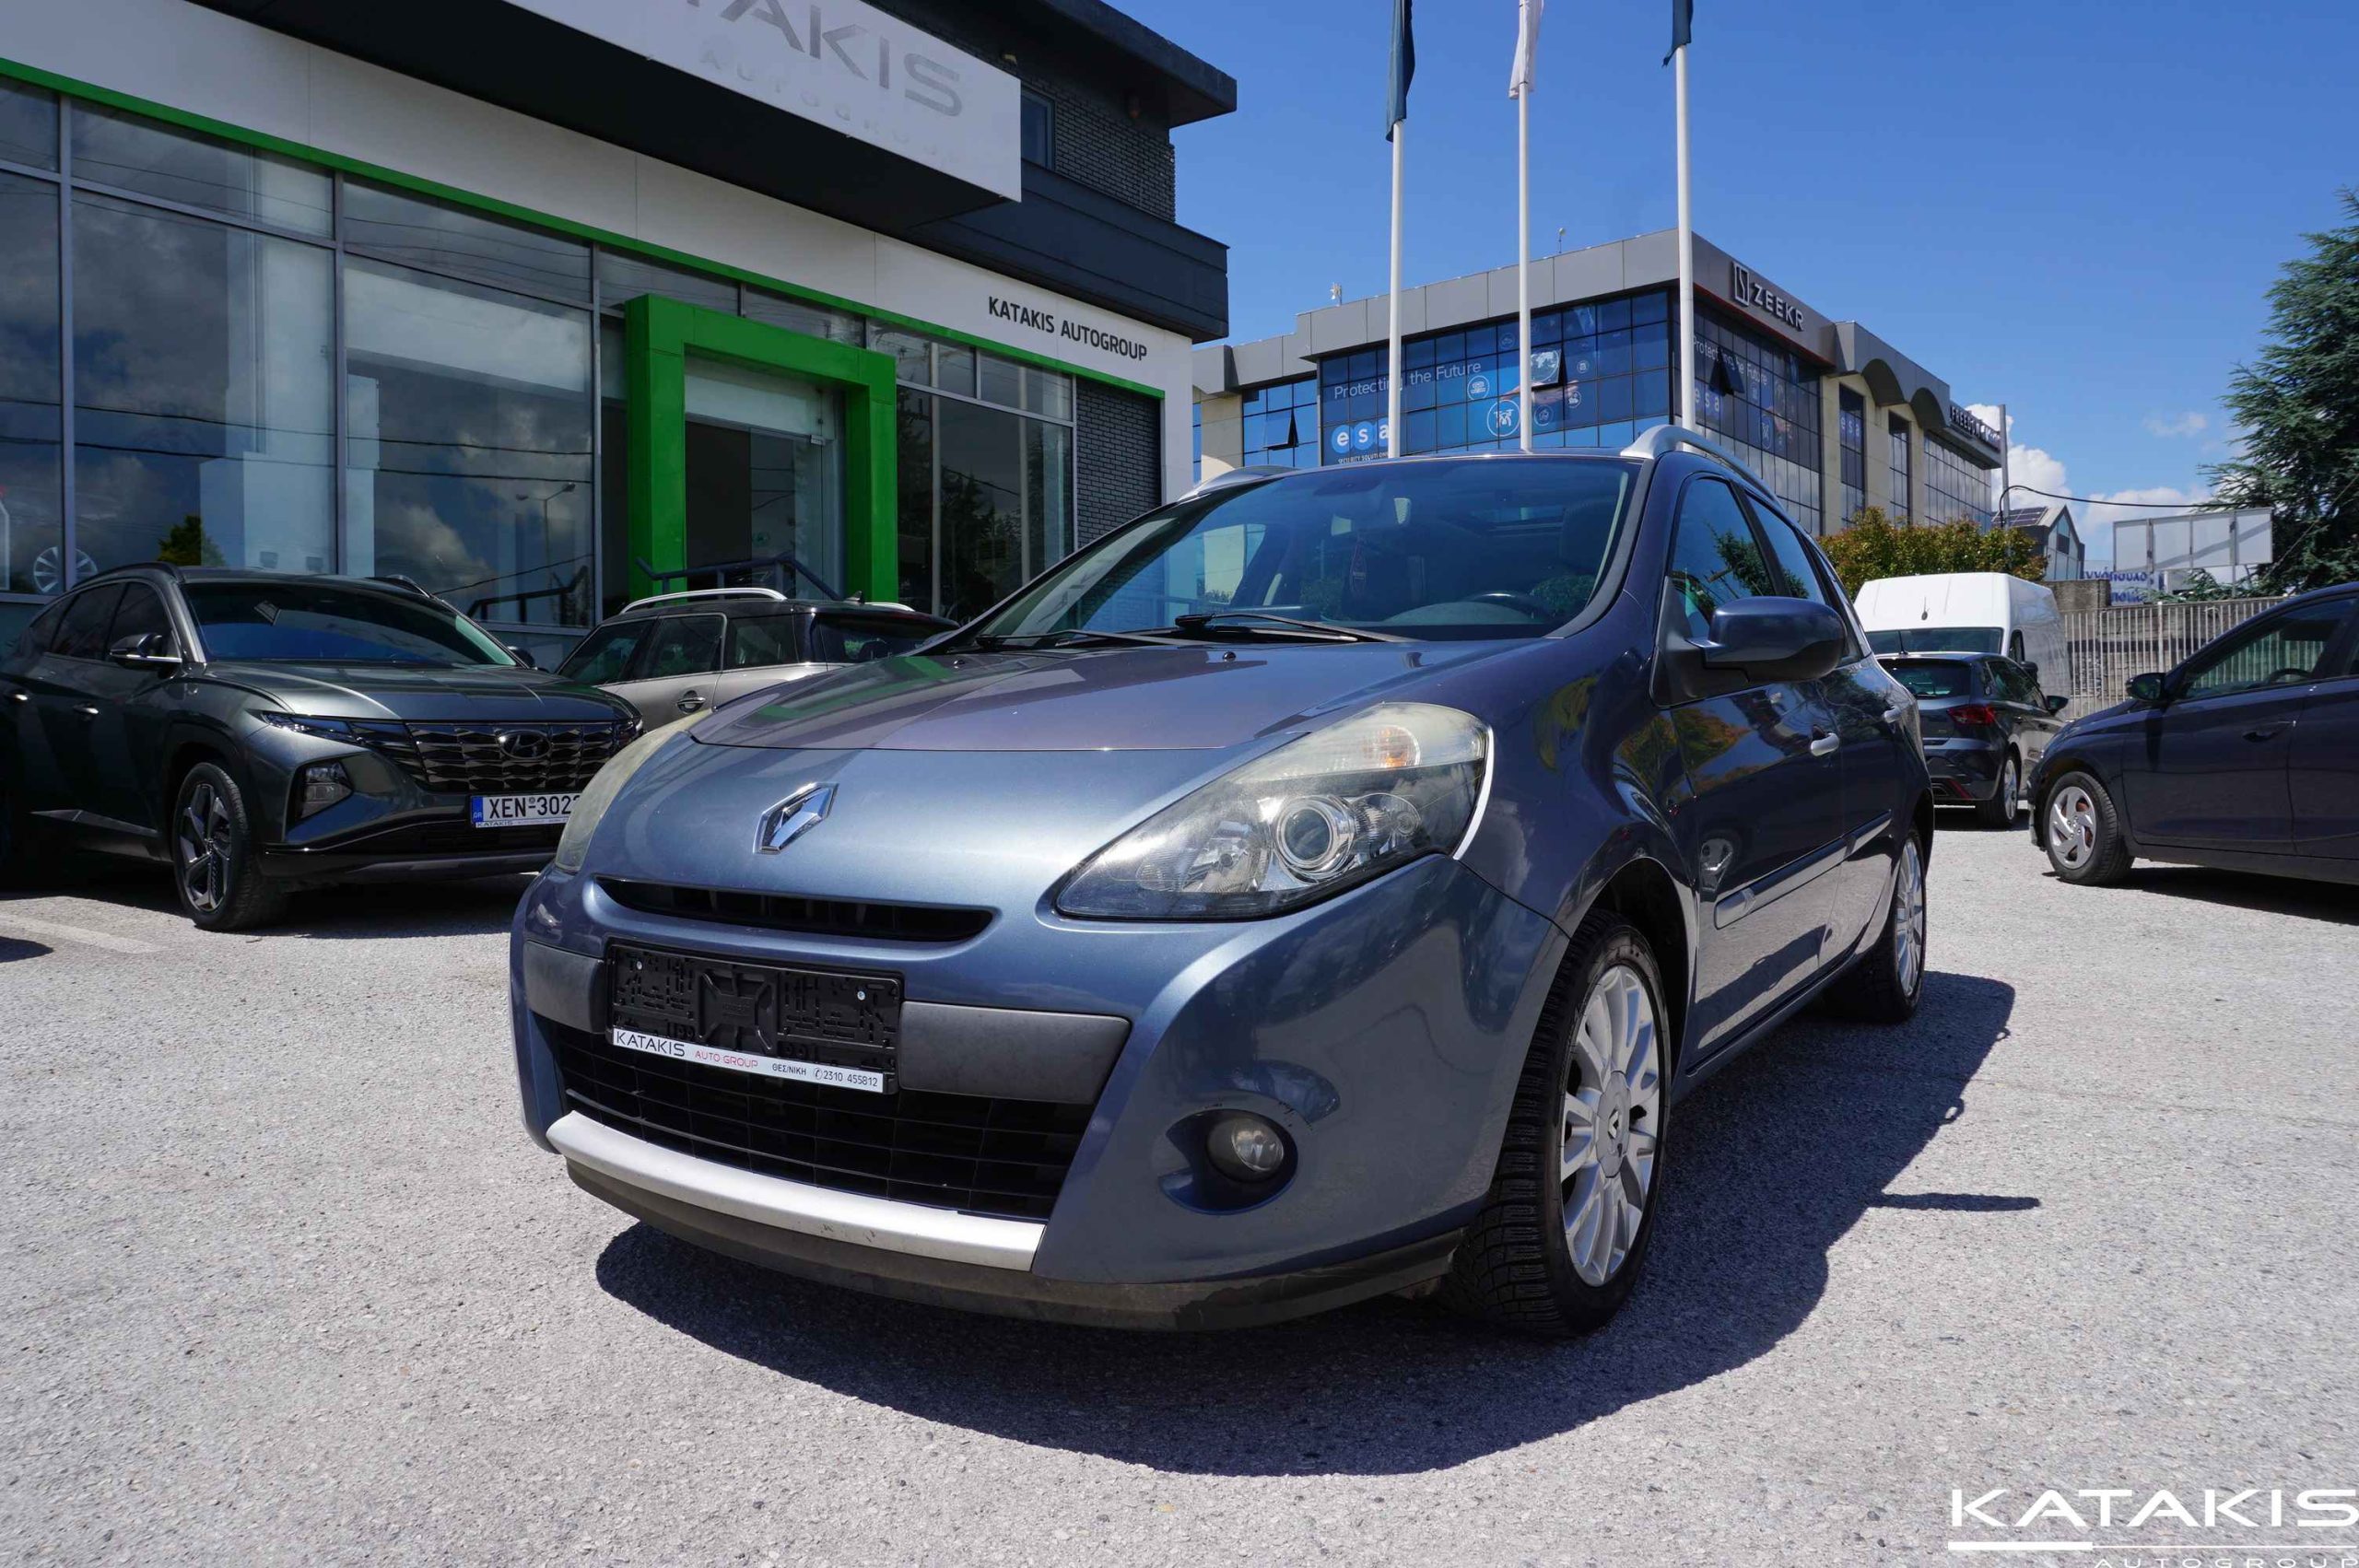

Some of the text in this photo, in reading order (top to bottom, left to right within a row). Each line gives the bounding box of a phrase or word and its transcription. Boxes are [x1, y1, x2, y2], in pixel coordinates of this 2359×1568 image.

[686, 0, 963, 117] AKIS
[1754, 283, 1804, 331] ZEEKR
[989, 296, 1147, 361] KATAKIS AUTOGROUP
[1334, 362, 1482, 400] Protecti the Future
[1337, 424, 1390, 447] esa
[1361, 452, 1389, 462] SOLUTION
[616, 1030, 758, 1069] KATAKIS AUTO GROUP
[823, 1070, 843, 1082] 2310
[847, 1073, 878, 1087] 455812
